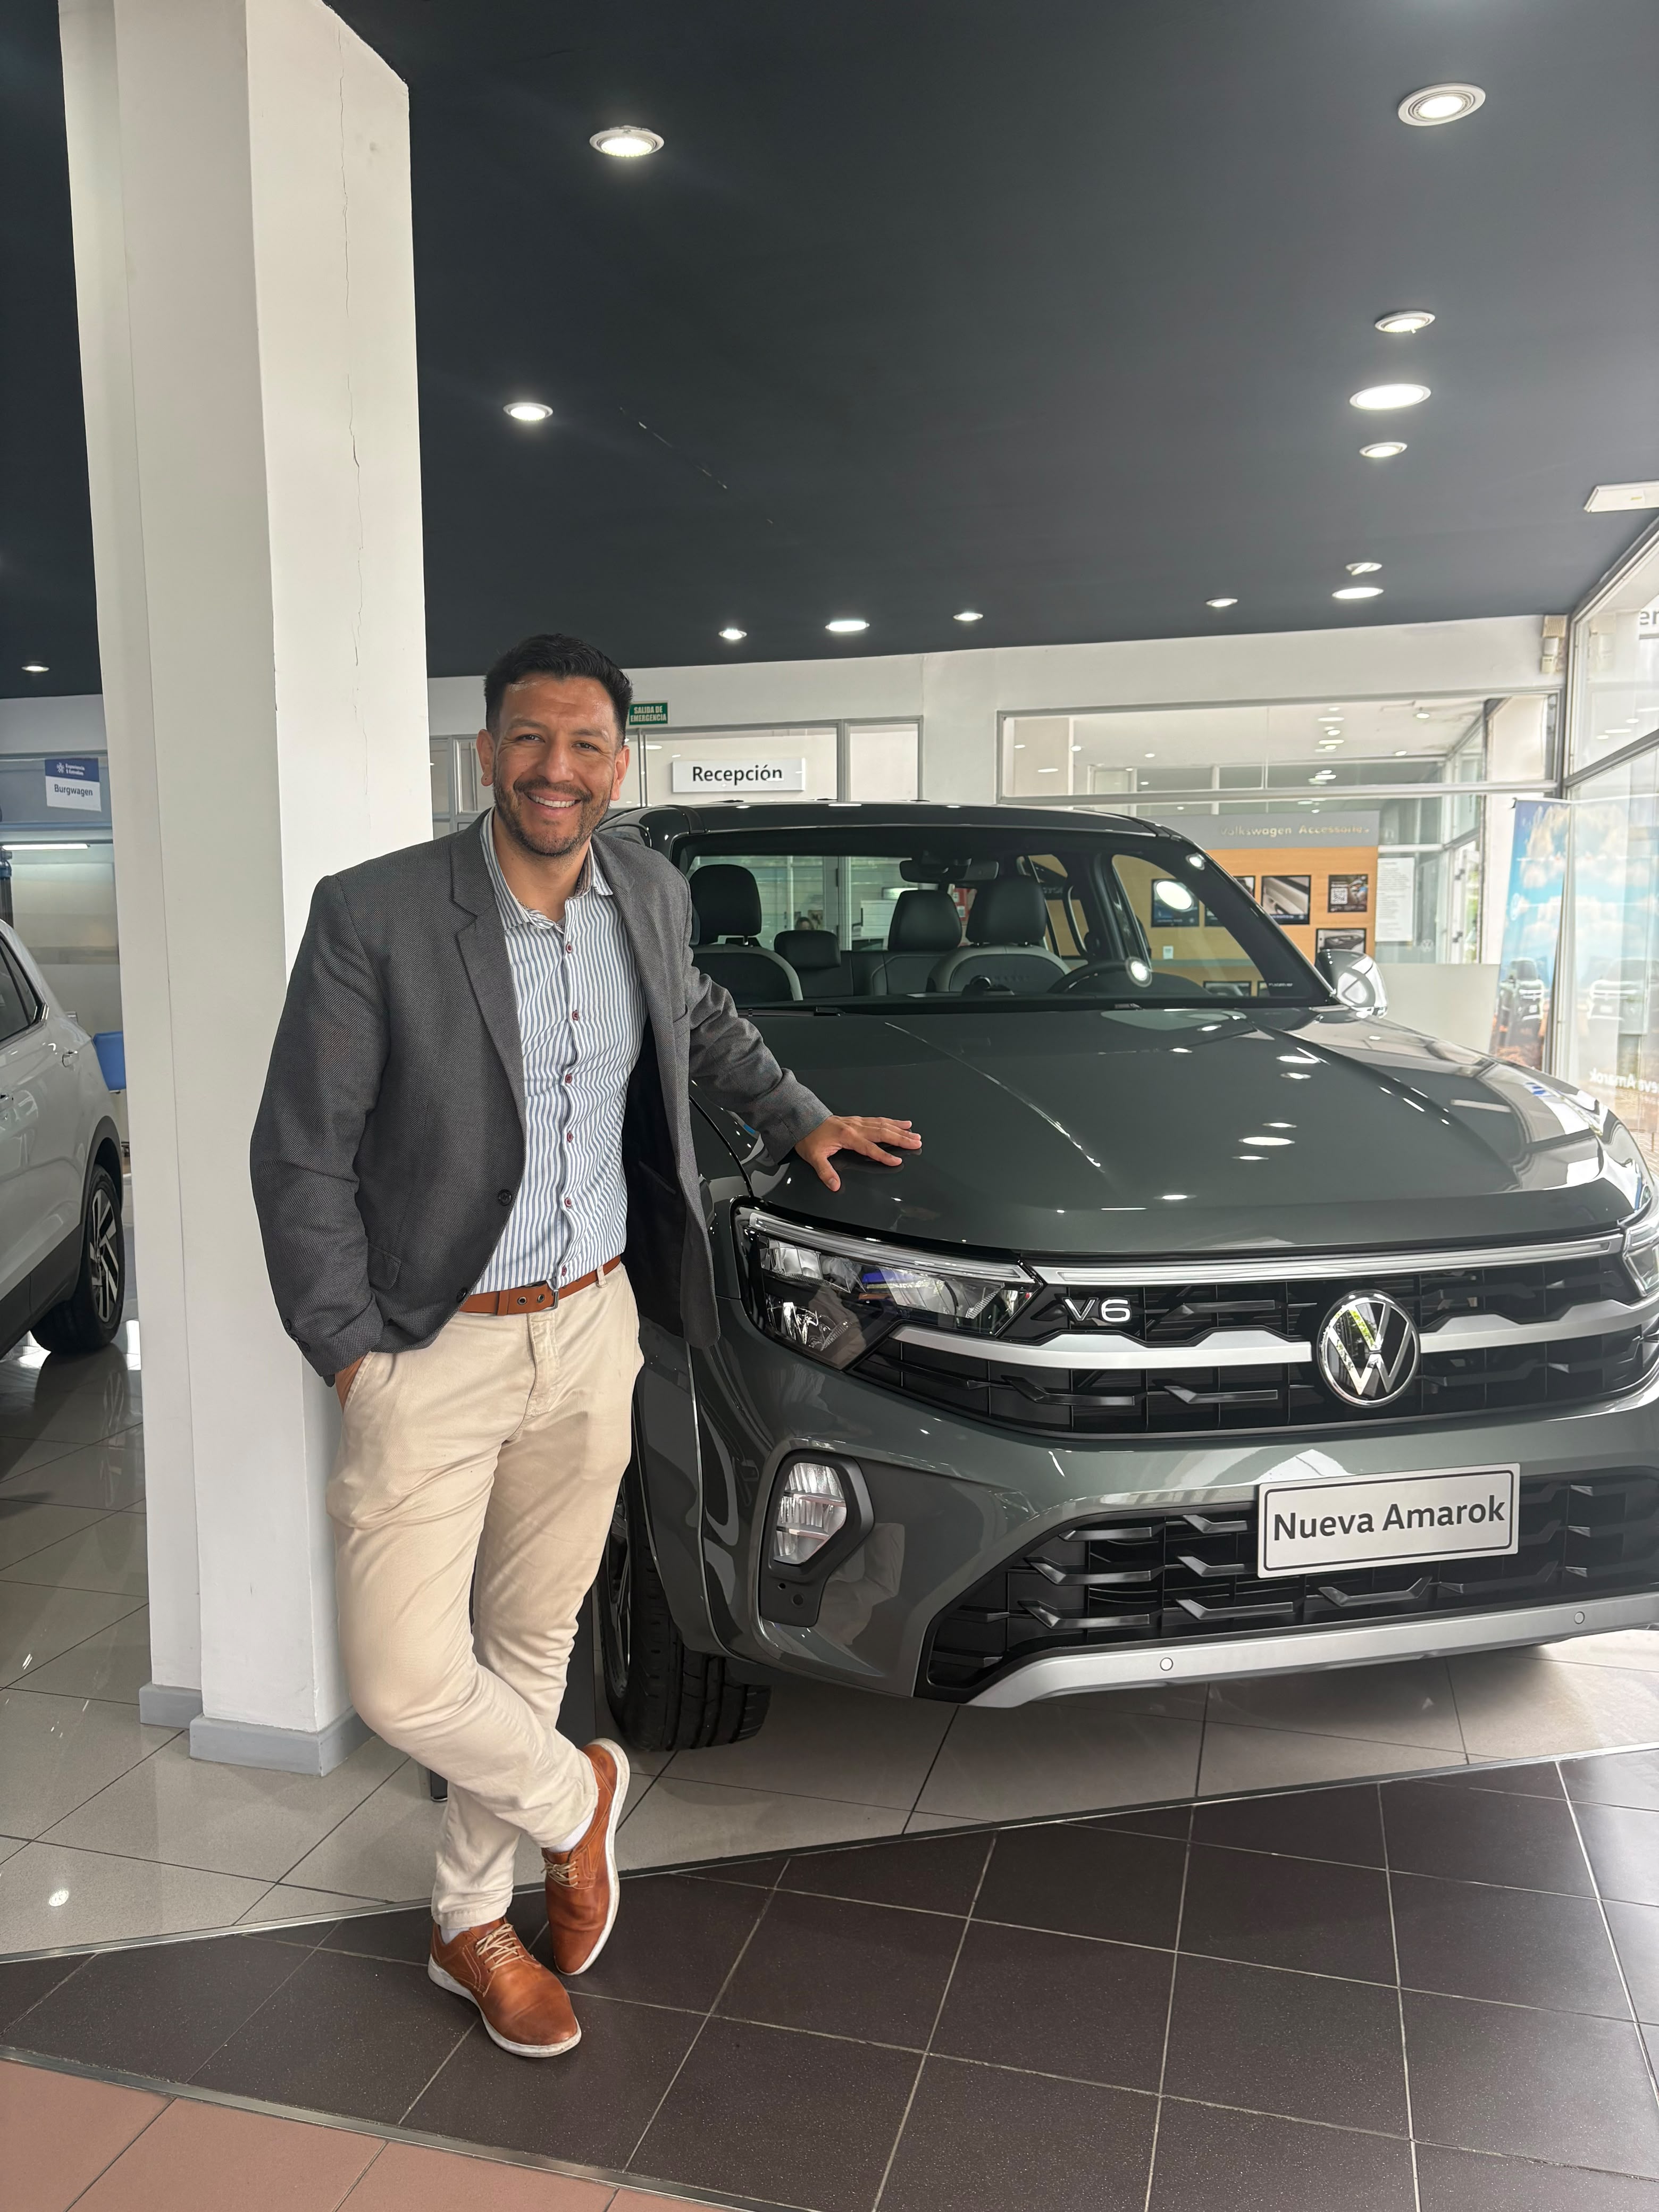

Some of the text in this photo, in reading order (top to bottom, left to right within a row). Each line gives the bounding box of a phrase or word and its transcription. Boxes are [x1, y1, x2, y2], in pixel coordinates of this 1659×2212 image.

[630, 714, 667, 722] EMERGENCIA
[693, 764, 782, 785] Recepción
[54, 784, 93, 797] Burgwagen
[1221, 825, 1292, 837] Volkswagen
[1063, 1298, 1131, 1322] V6
[1273, 1495, 1505, 1541] Nueva Amarok
